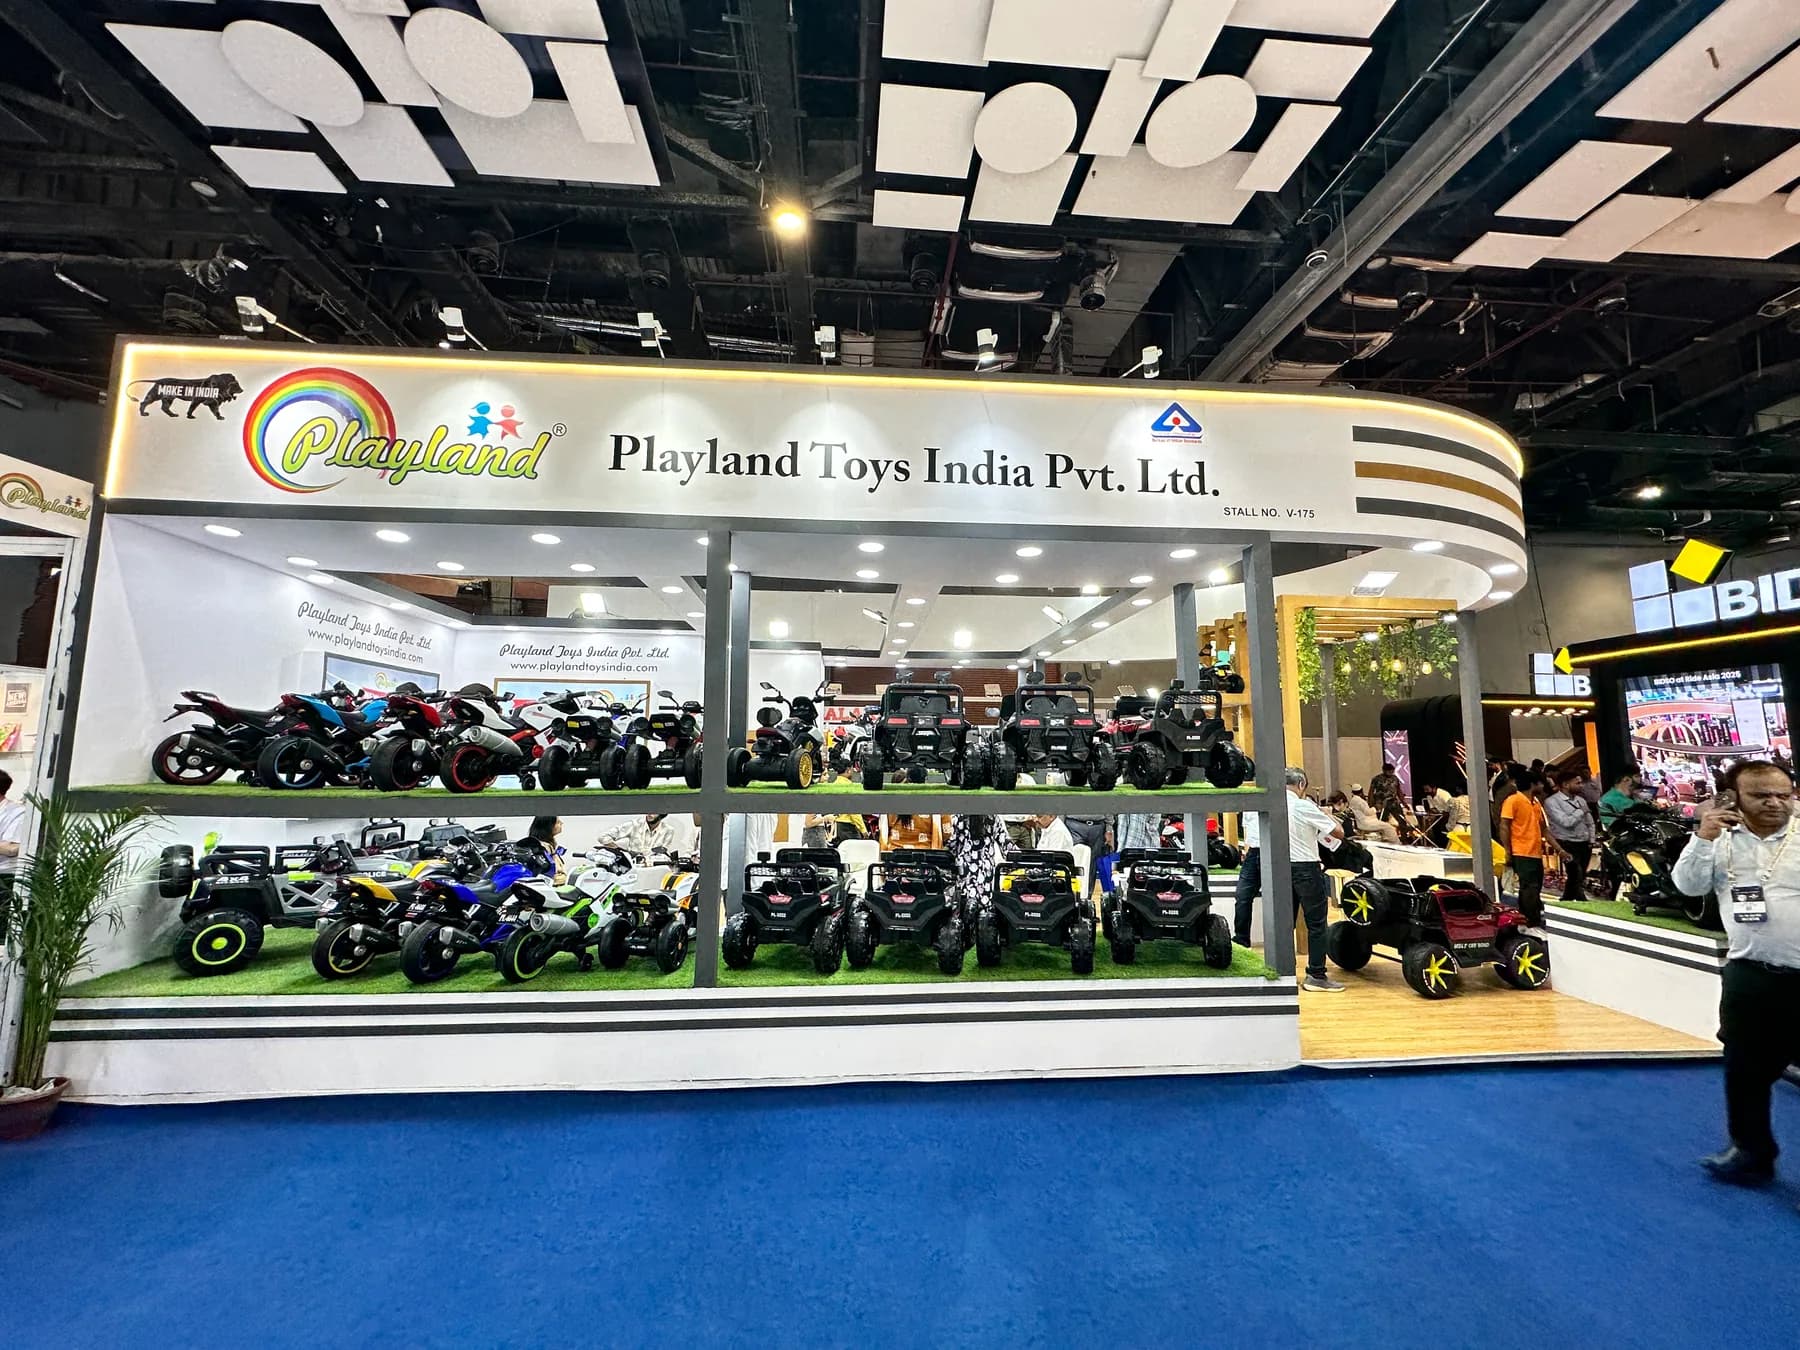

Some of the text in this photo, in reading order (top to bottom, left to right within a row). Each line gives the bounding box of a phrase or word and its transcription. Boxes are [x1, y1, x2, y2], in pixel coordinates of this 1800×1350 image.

[157, 385, 220, 398] MAKE IN INDIA
[282, 416, 552, 485] Playland
[608, 434, 1220, 497] Playland Toys India Pvt. Ltd.
[7, 487, 91, 520] Playland
[1223, 507, 1315, 518] STALL NO. V-175
[298, 601, 350, 627] Playland
[349, 615, 372, 635] Toys
[373, 622, 399, 641] India
[308, 627, 424, 664] www.playlandtoysindia.com
[499, 643, 555, 658] Playland
[556, 645, 582, 658] Toys
[586, 646, 618, 658] India
[646, 647, 670, 658] Ltd.
[510, 661, 658, 673] www.playlandtoysindia.com
[1685, 675, 1701, 683] Ride
[1703, 673, 1720, 681] Asia
